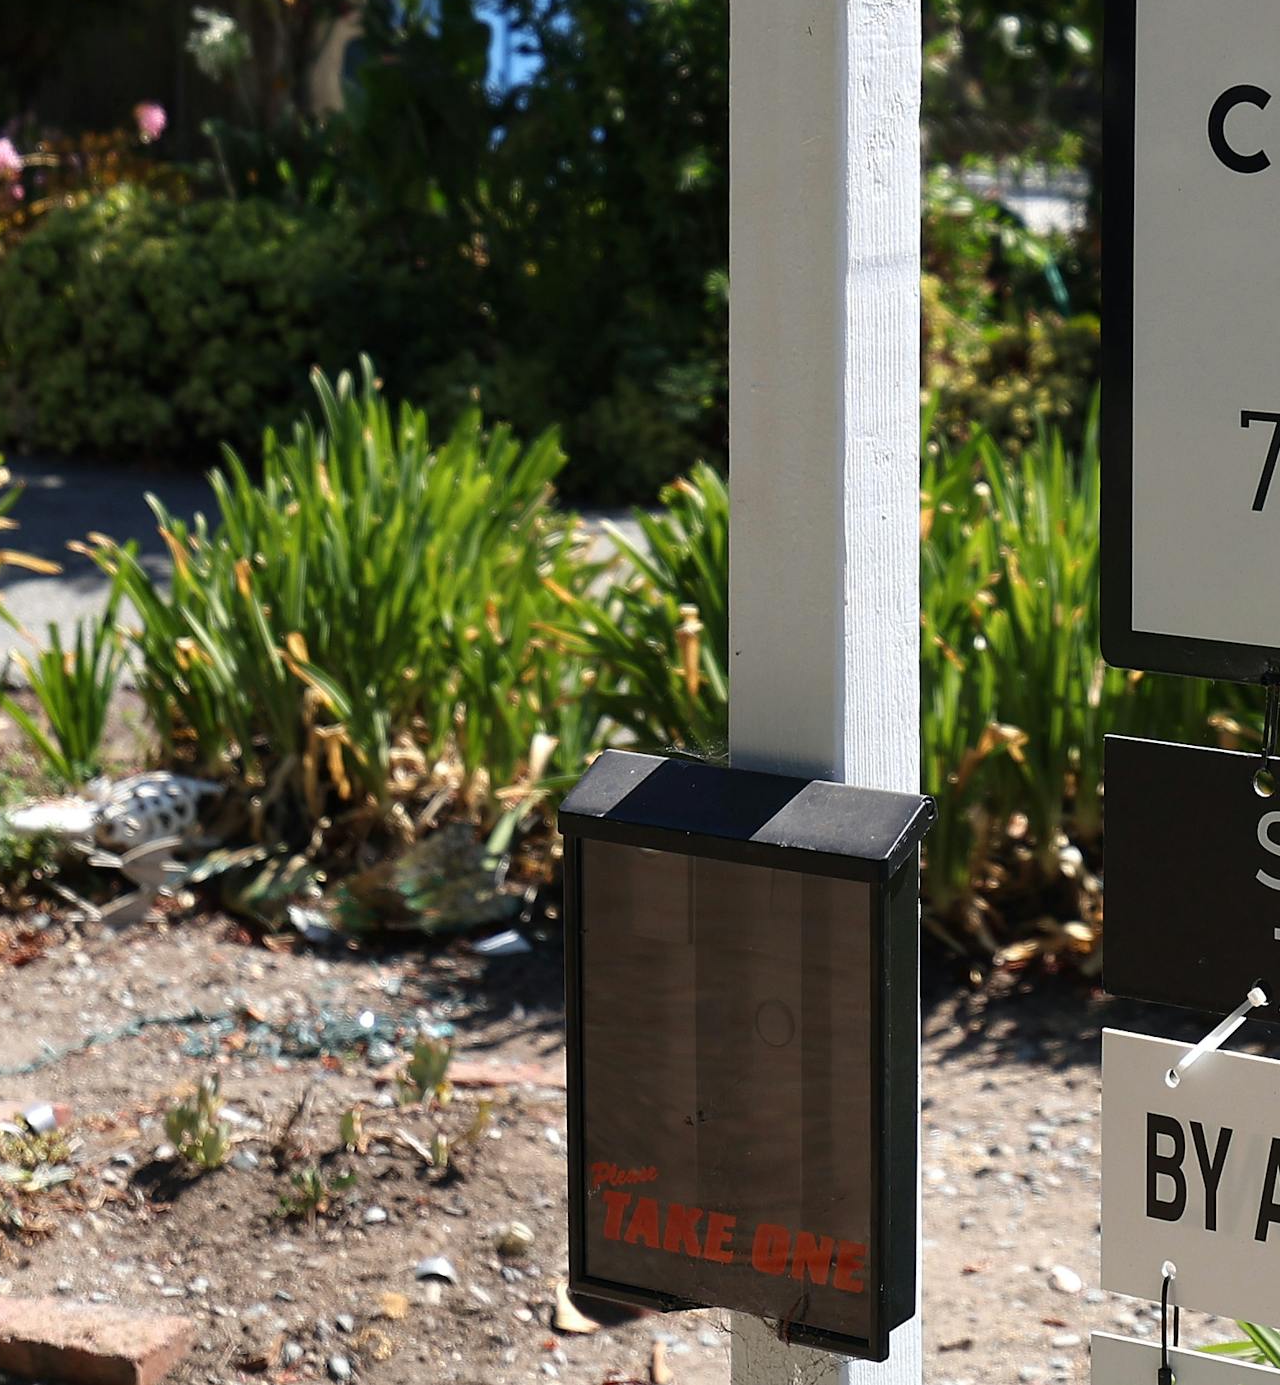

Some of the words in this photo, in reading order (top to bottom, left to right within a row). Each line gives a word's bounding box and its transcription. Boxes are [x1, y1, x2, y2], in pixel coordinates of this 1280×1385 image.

[1146, 1111, 1233, 1232] BY
[603, 1190, 737, 1264] TAKE
[751, 1223, 867, 1294] ONE
